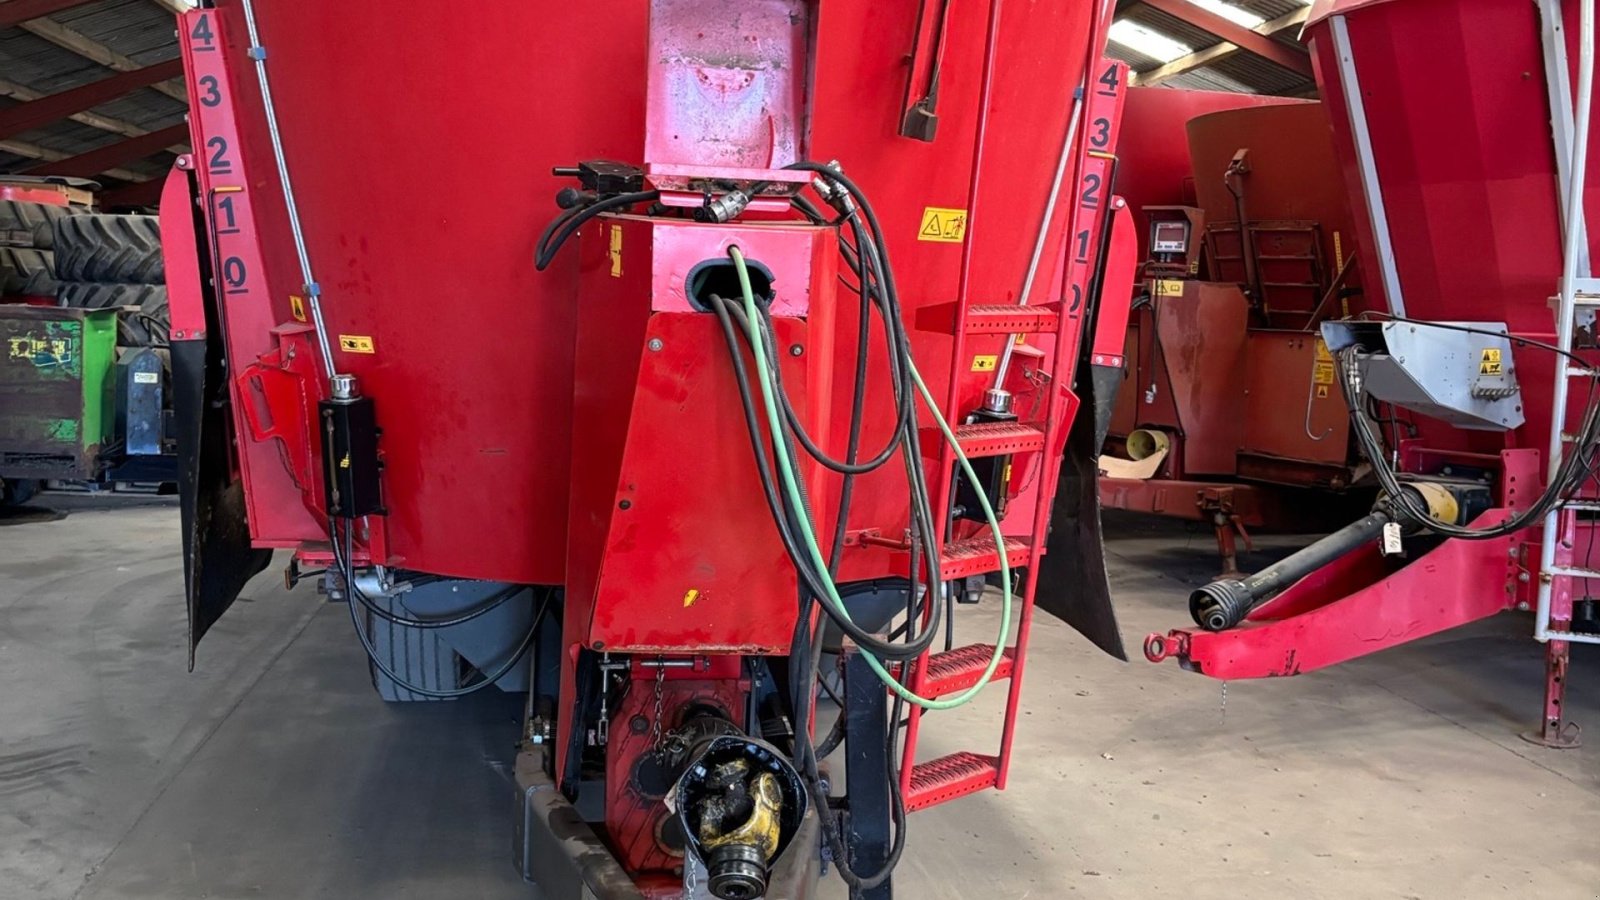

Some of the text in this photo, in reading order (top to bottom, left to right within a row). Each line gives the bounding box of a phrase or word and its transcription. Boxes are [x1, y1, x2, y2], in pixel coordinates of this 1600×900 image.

[191, 13, 214, 46] 4
[199, 75, 222, 108] 3
[1099, 63, 1119, 91] 4
[1090, 118, 1110, 147] 3
[206, 136, 231, 168] 2
[1081, 174, 1101, 204] 2
[218, 196, 236, 228] 1
[1077, 229, 1090, 258] 1
[224, 256, 247, 287] 0
